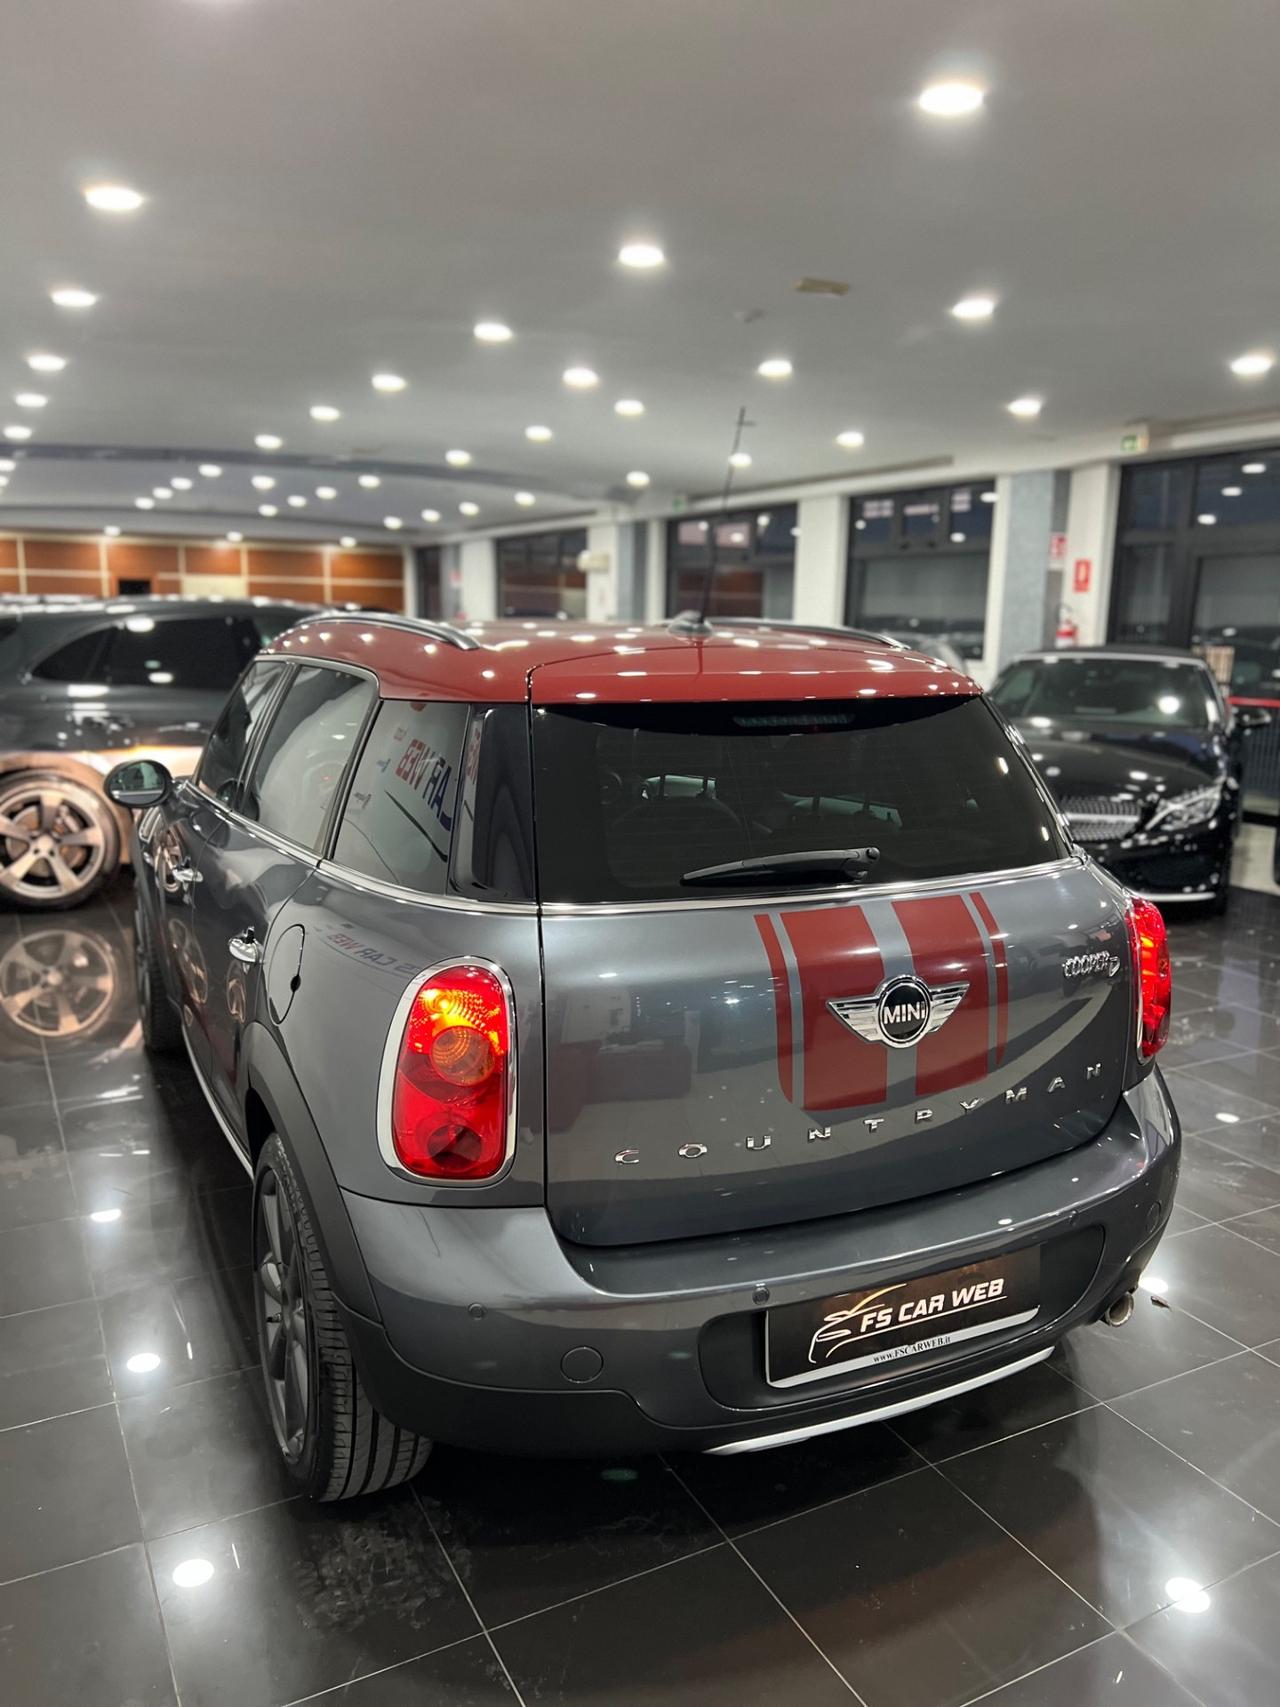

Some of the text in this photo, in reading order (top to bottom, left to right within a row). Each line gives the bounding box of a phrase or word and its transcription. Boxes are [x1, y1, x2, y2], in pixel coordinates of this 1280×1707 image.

[1062, 950, 1110, 977] COOPER
[883, 1001, 926, 1025] MINI
[614, 1063, 1102, 1165] COUNTRYMAN
[859, 1278, 1005, 1333] FS CAR WEB
[873, 1336, 951, 1363] www.FSCARWEB.it
